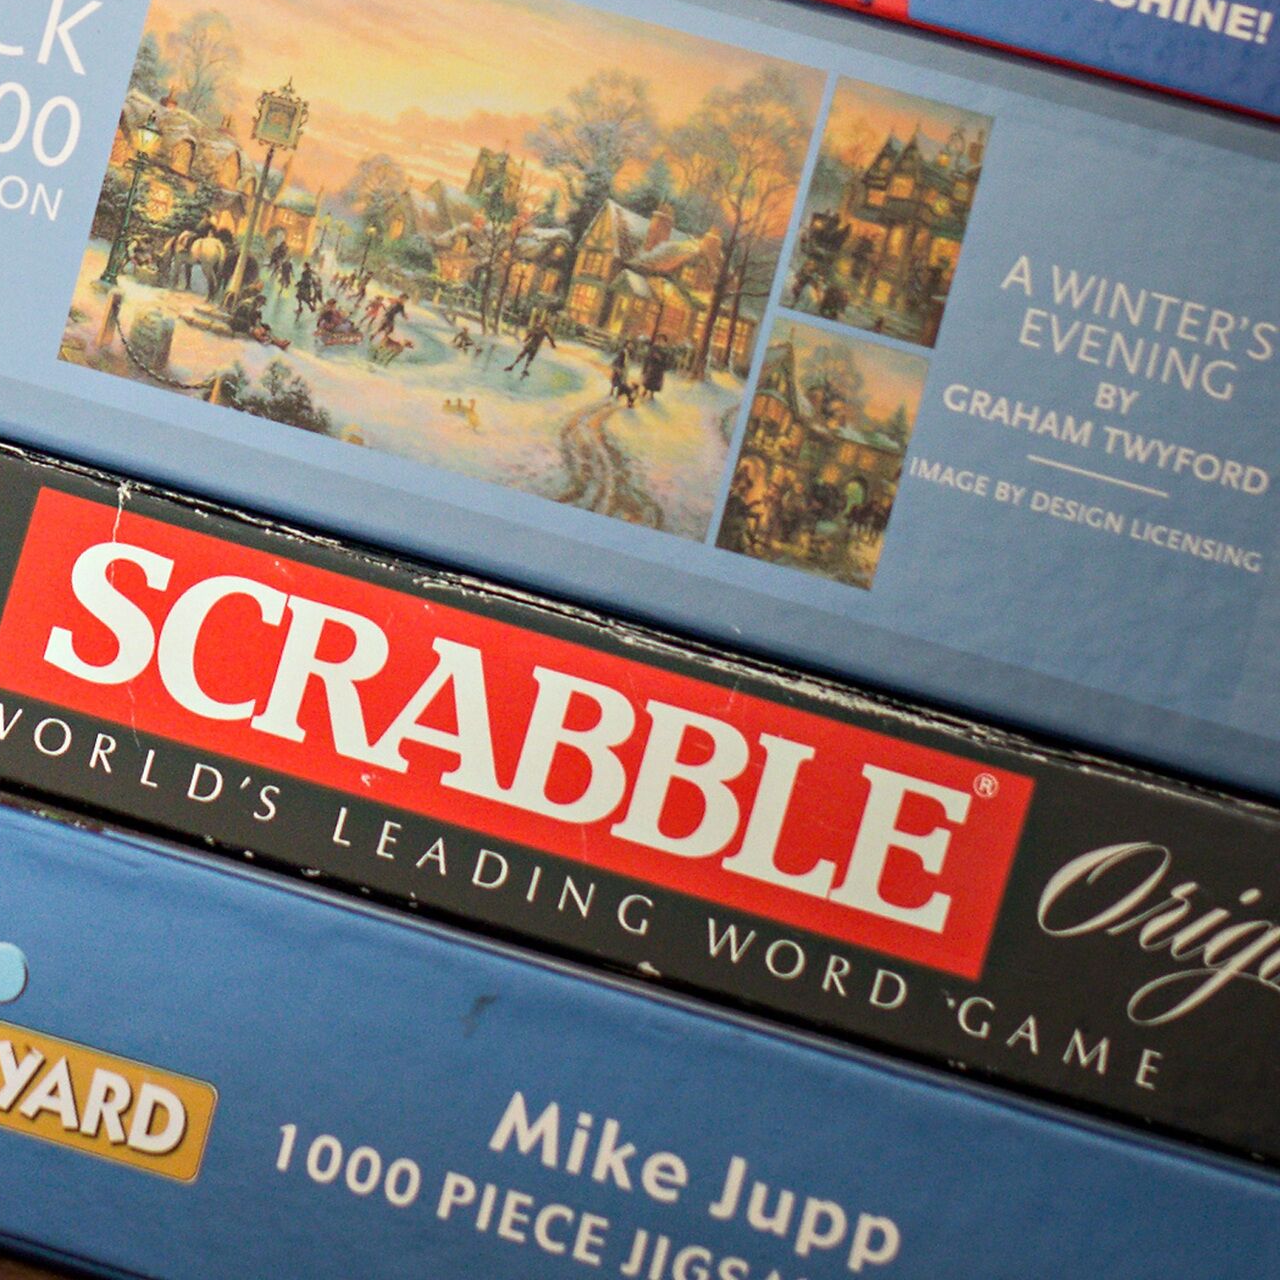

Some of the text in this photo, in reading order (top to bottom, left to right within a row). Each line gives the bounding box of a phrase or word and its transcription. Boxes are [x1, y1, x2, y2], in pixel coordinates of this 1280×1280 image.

[1000, 254, 1279, 362] A WINTER'S
[1018, 307, 1238, 402] EVENING
[942, 383, 1270, 496] GRAHAM TWYFORD
[1093, 381, 1140, 415] BY
[908, 456, 1263, 574] IMAGE BY DESIGN LICENSING
[42, 539, 977, 936] SCRABBLE
[332, 806, 657, 938] LEADING
[706, 914, 911, 1012] WORD
[953, 995, 1167, 1094] GAME
[273, 1121, 611, 1268] 1000 PIECE
[487, 1089, 904, 1271] Mike Jupp
